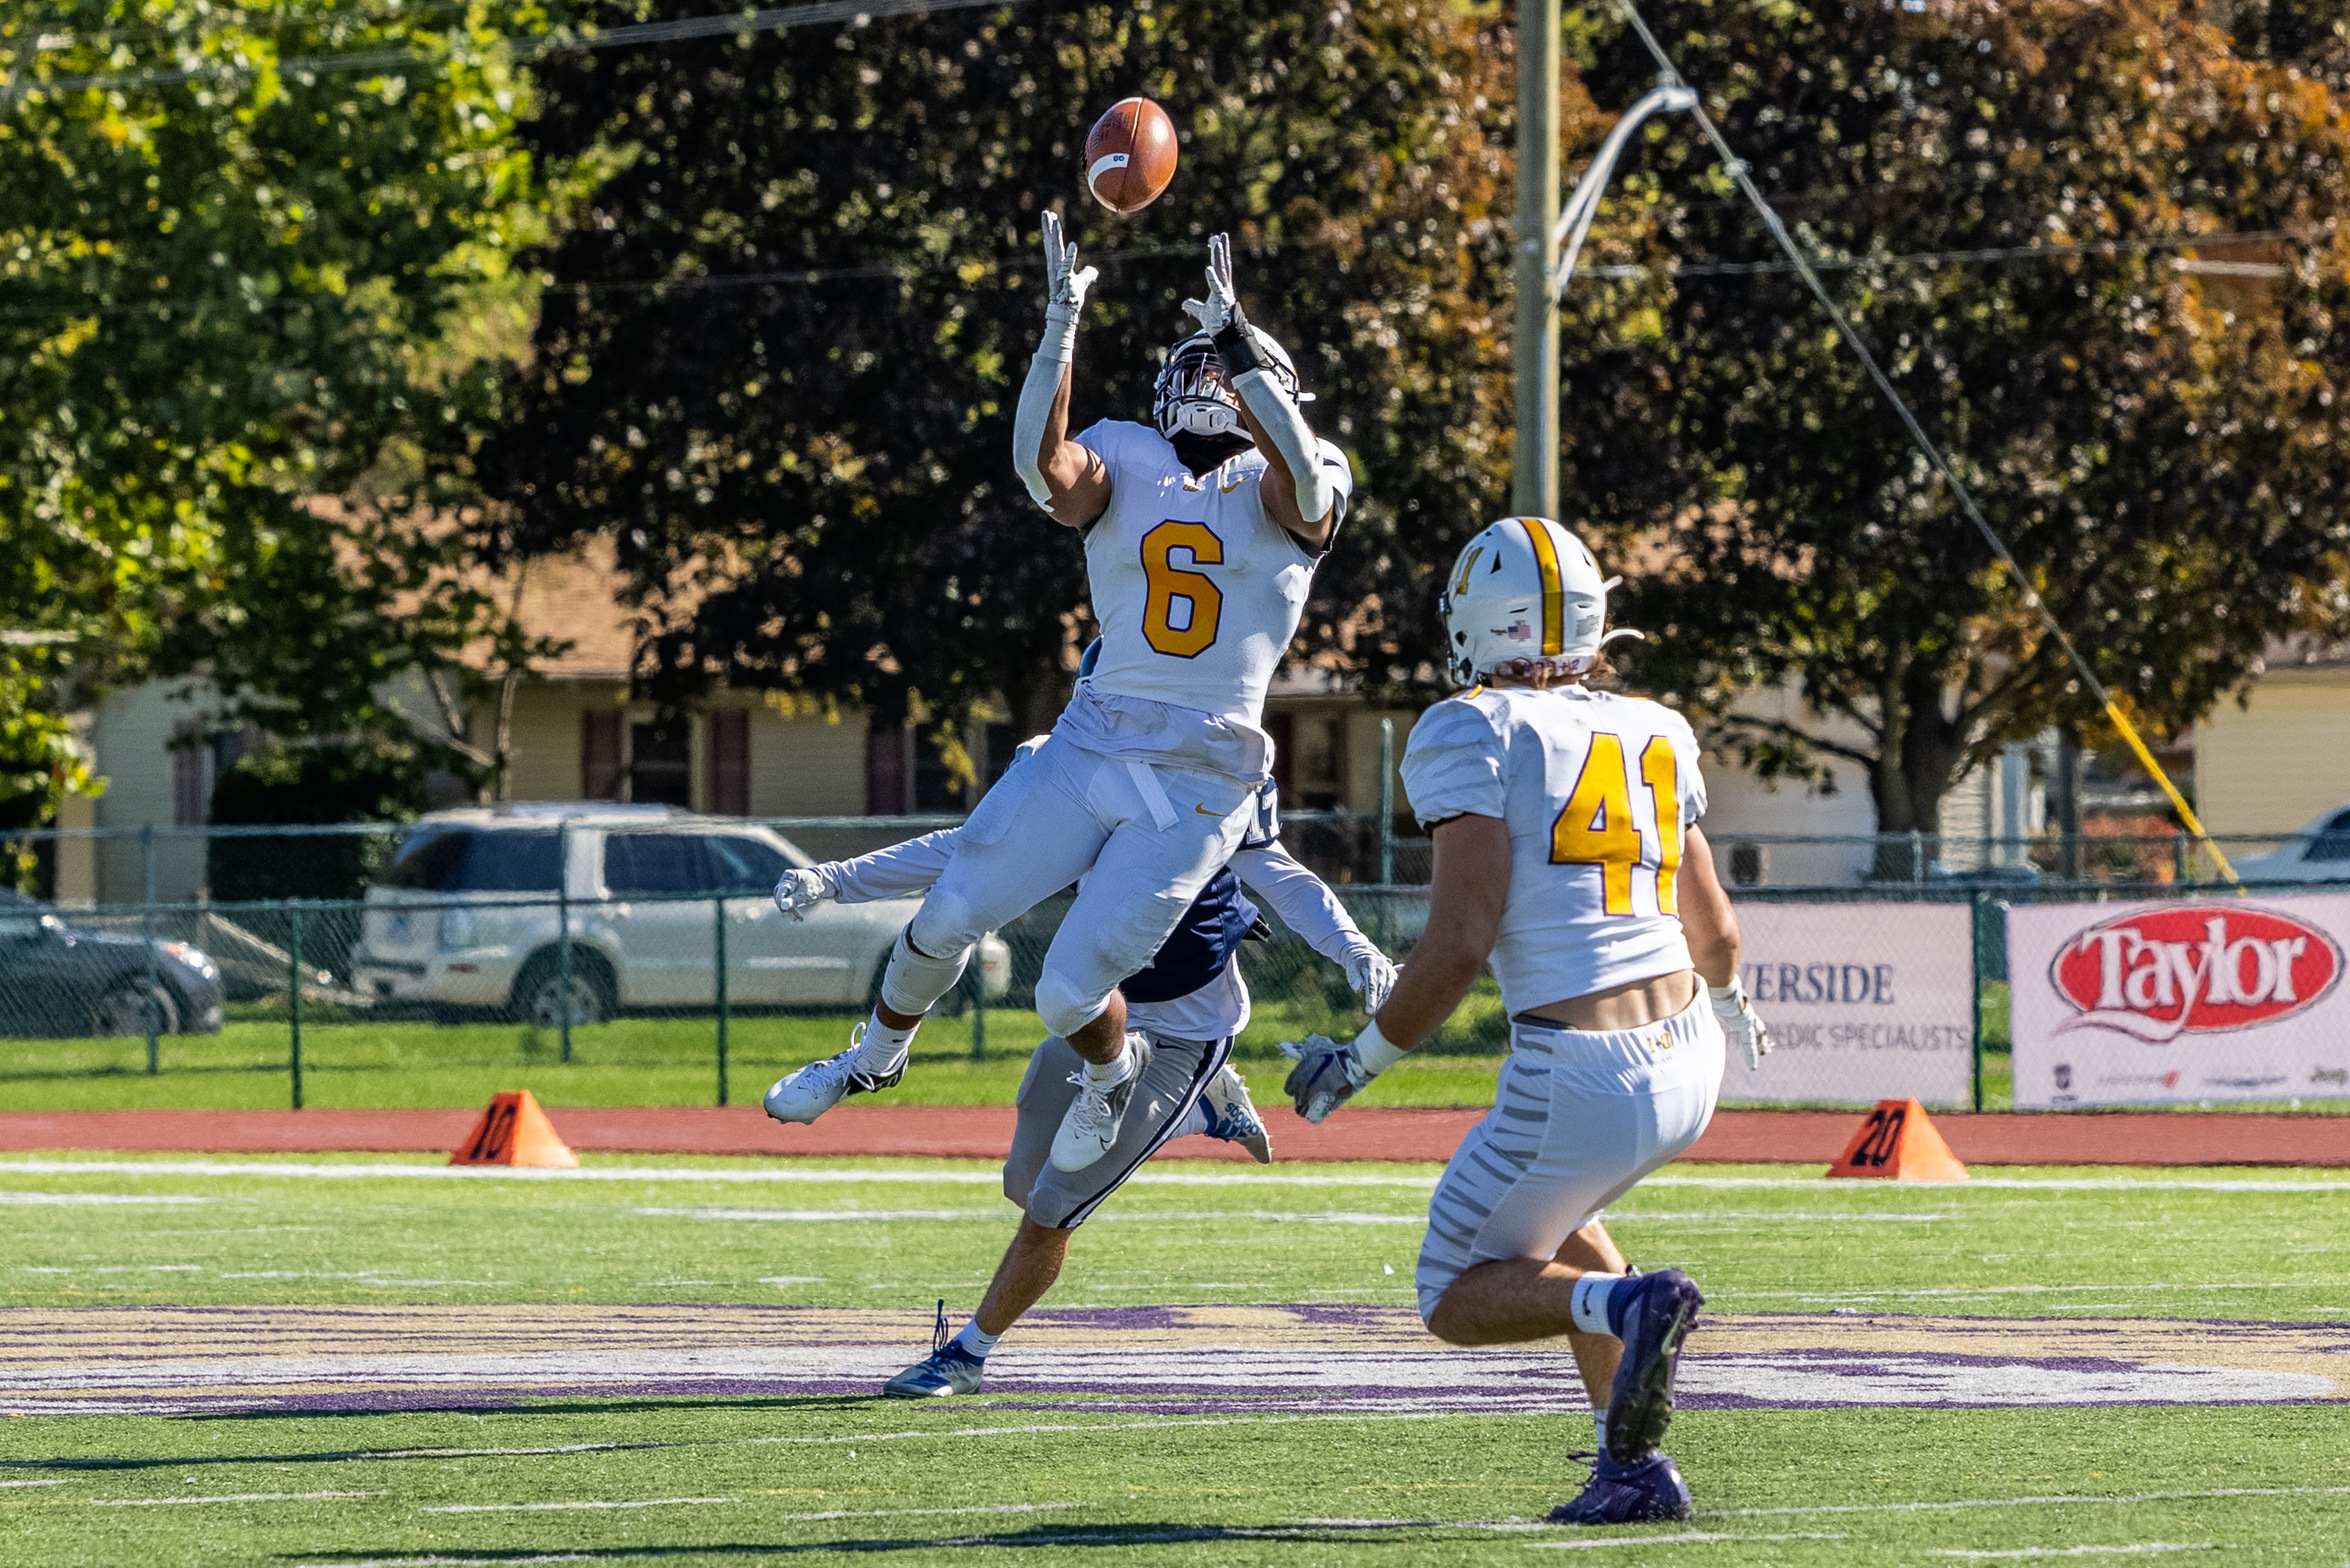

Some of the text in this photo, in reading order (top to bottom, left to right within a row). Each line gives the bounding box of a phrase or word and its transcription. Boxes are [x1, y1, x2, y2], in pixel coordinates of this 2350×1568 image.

[1140, 518, 1225, 660] 6
[1547, 730, 1680, 918] 41
[2052, 916, 2308, 1043] Taylor
[469, 1103, 516, 1161] 10
[1224, 1102, 1261, 1136] adidas
[1850, 1108, 1906, 1167] 20
